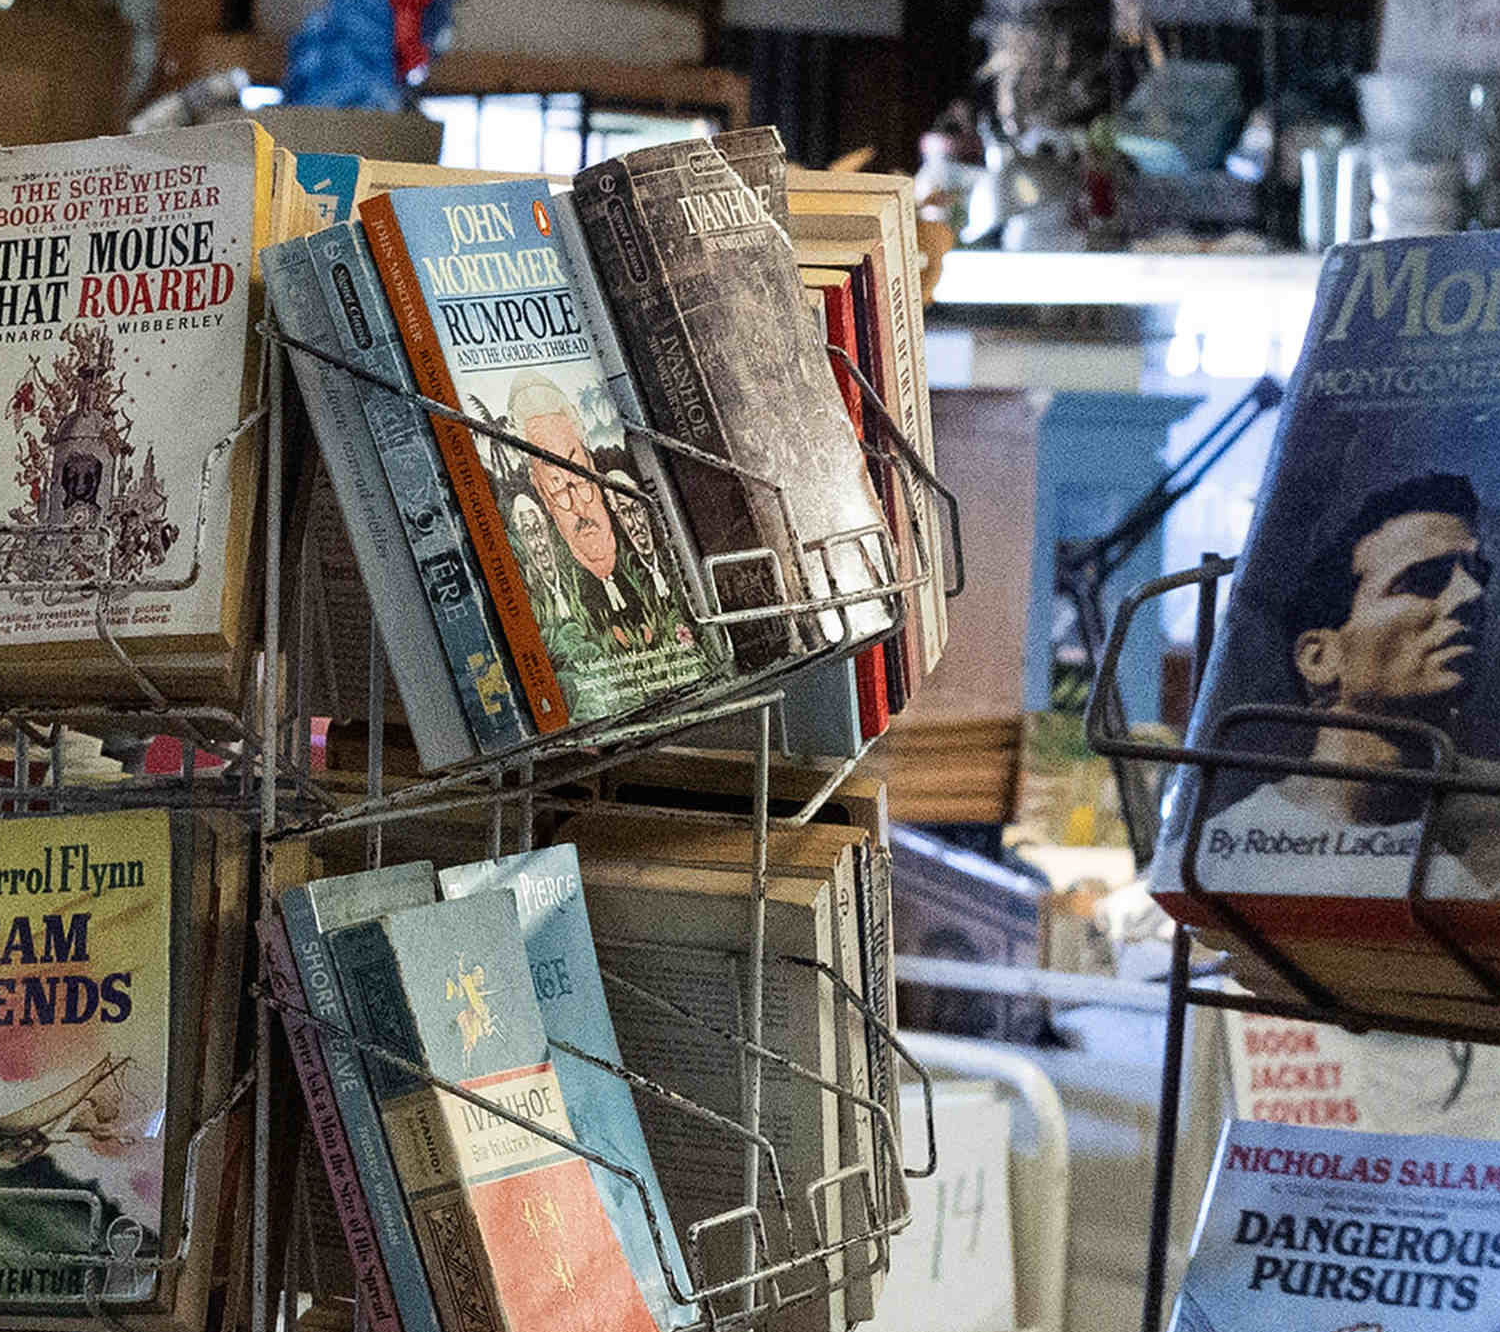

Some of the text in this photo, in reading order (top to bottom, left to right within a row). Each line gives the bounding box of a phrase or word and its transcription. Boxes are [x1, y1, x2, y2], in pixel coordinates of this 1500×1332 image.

[12, 166, 208, 204] THE SCREWIEST
[63, 201, 92, 222] OF
[99, 195, 148, 217] THE
[158, 186, 221, 208] YEAR
[441, 201, 514, 249] JOHN
[86, 221, 214, 275] MOUSE
[75, 262, 234, 318] ROARED
[421, 244, 568, 301] MORTIMER
[117, 314, 224, 334] WIBBERLEY
[440, 293, 584, 349] RUMPOLE
[456, 336, 590, 367] AND THE GOLDEN THREAD
[60, 844, 145, 897] Flynn
[1243, 1025, 1321, 1058] BOOK
[1249, 1062, 1342, 1095] JACKET
[317, 1112, 342, 1151] Man
[327, 1148, 351, 1182] the
[1225, 1144, 1391, 1185] NICHOLAS
[337, 1179, 360, 1216] Size
[359, 1263, 392, 1324] Spread
[1247, 1255, 1480, 1314] PURSUITS
